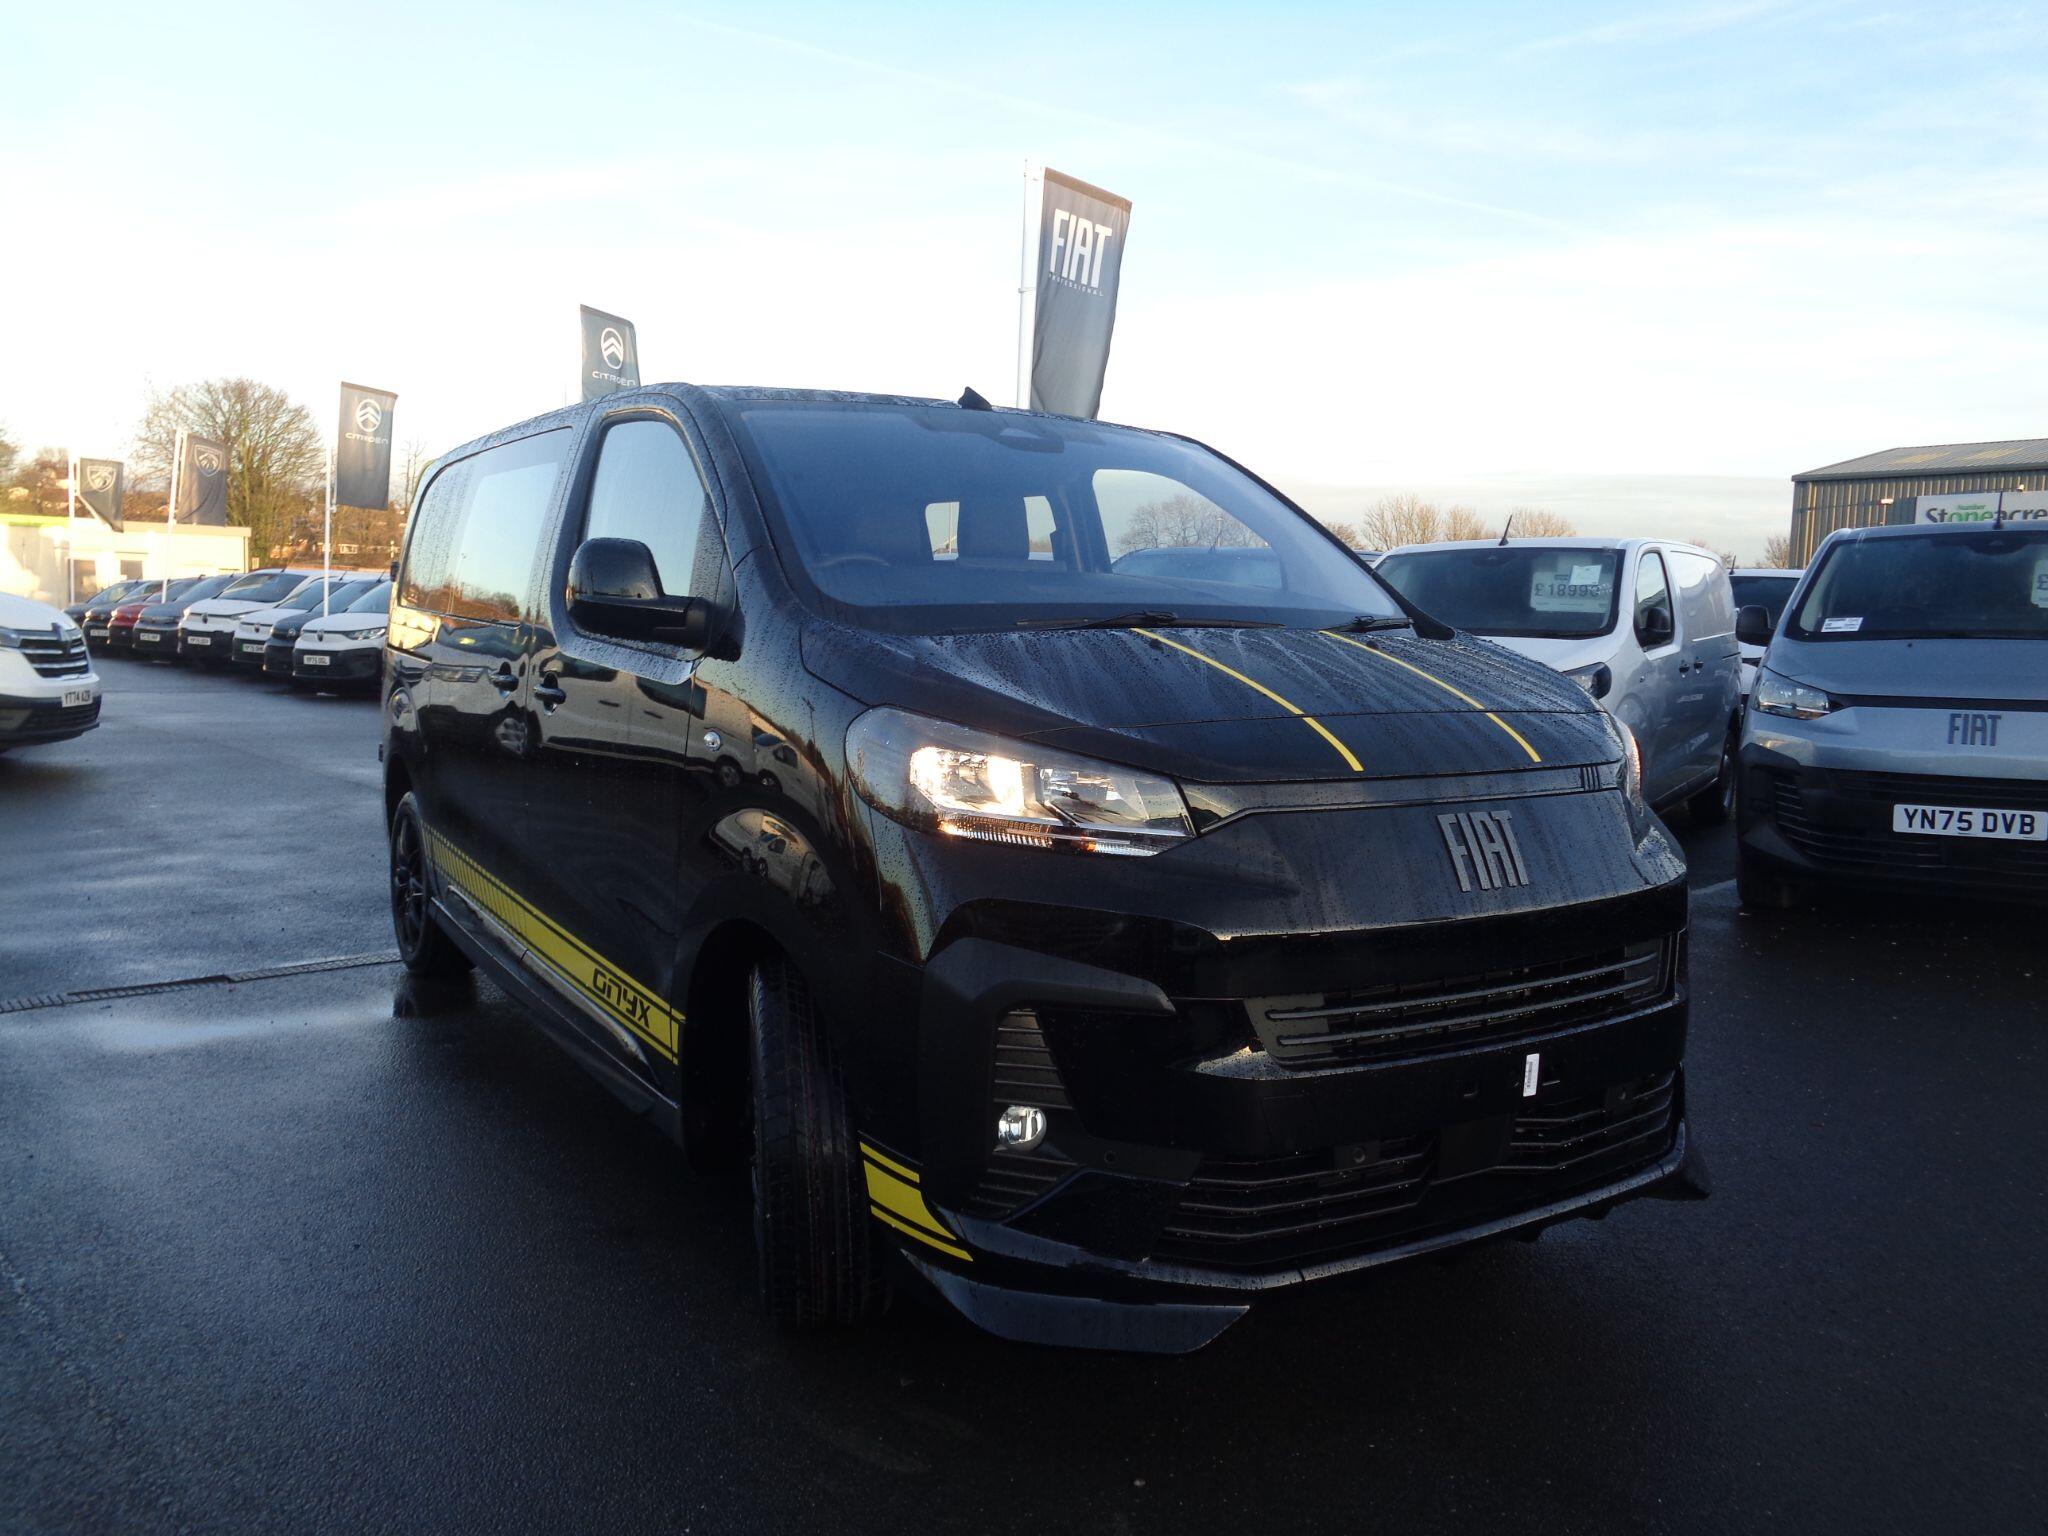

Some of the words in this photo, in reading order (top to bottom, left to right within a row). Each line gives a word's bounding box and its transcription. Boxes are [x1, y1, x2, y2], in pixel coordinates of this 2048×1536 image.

[1050, 207, 1112, 289] FIAT
[1948, 713, 2002, 747] FIAT
[1904, 808, 1974, 832] YN75
[1982, 812, 2035, 835] DVB
[1437, 810, 1530, 892] FIAT
